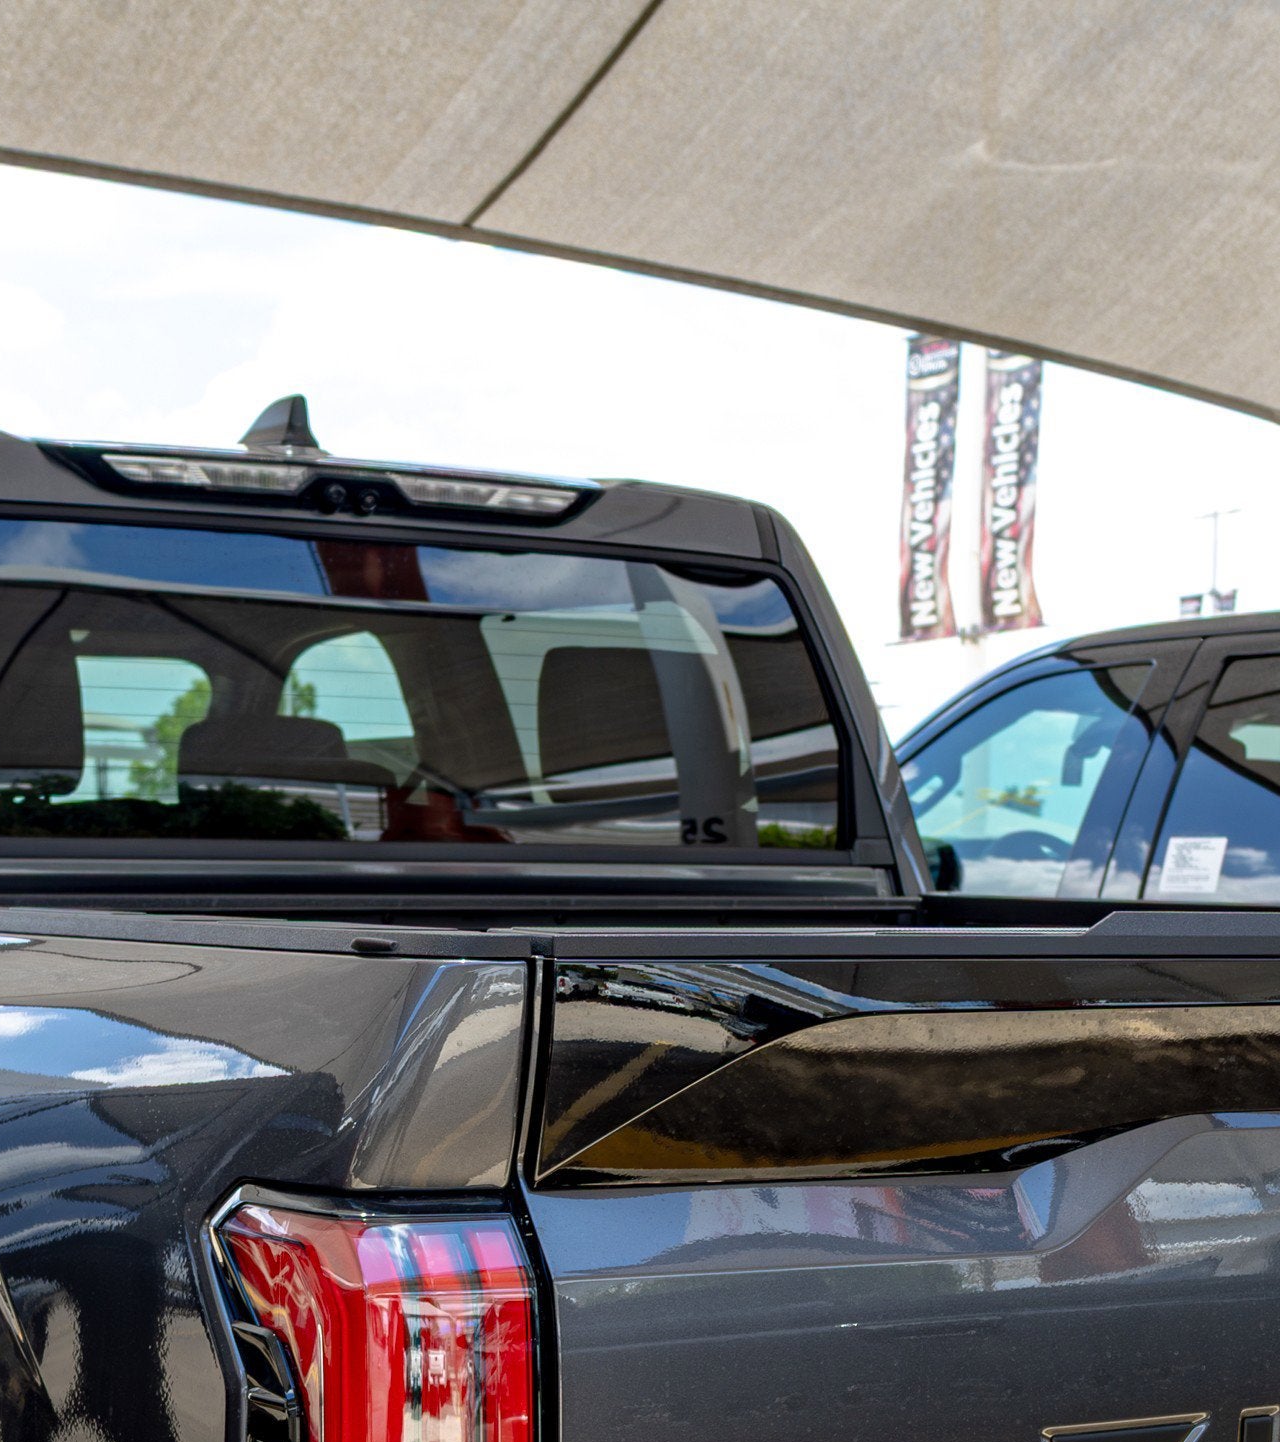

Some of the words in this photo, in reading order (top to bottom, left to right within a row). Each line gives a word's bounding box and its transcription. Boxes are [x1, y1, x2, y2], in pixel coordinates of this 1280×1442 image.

[910, 402, 939, 548] Vehicles
[991, 383, 1023, 536] Vehicles
[911, 552, 938, 626] New
[993, 540, 1021, 616] New
